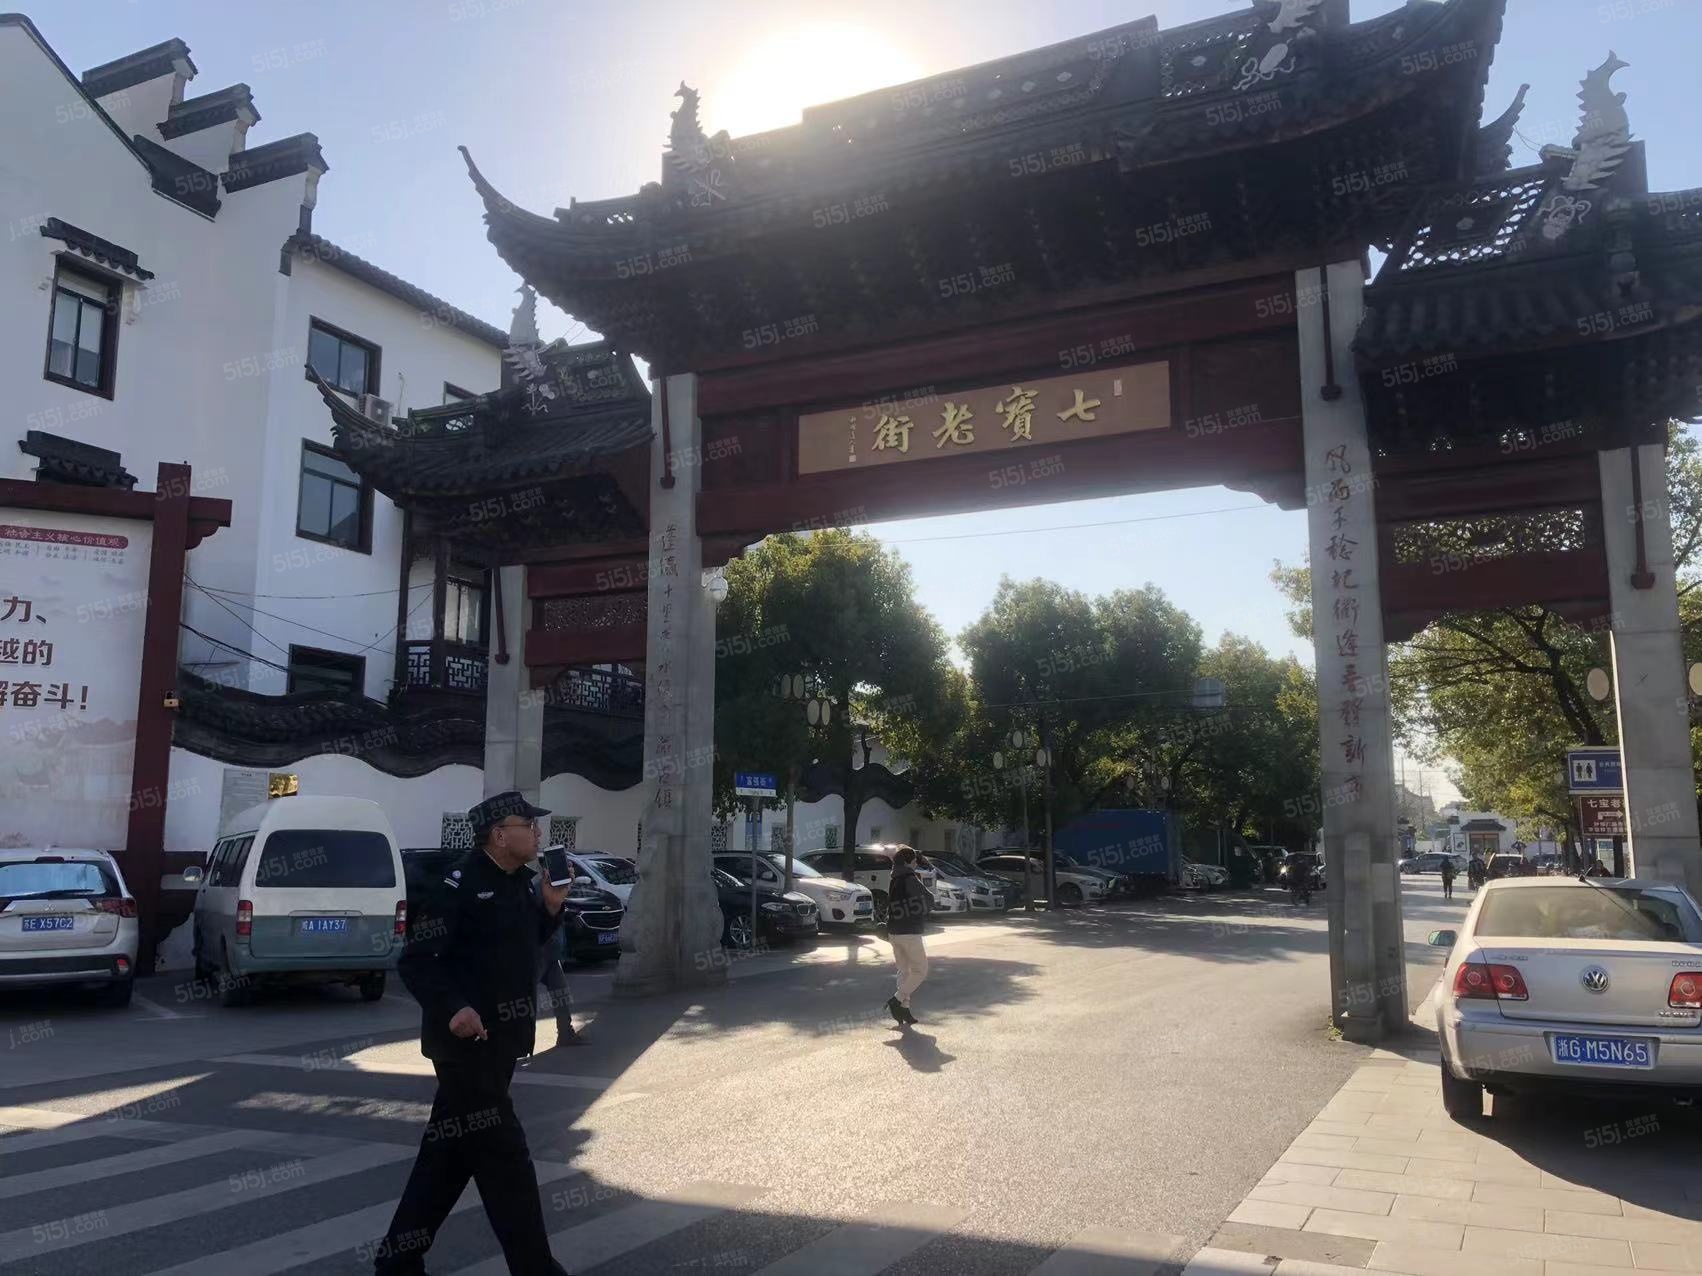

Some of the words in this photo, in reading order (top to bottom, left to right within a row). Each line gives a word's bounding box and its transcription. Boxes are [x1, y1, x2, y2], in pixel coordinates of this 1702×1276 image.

[4, 528, 121, 547] 社会主义核心价值观
[1587, 799, 1624, 808] 七宝老
